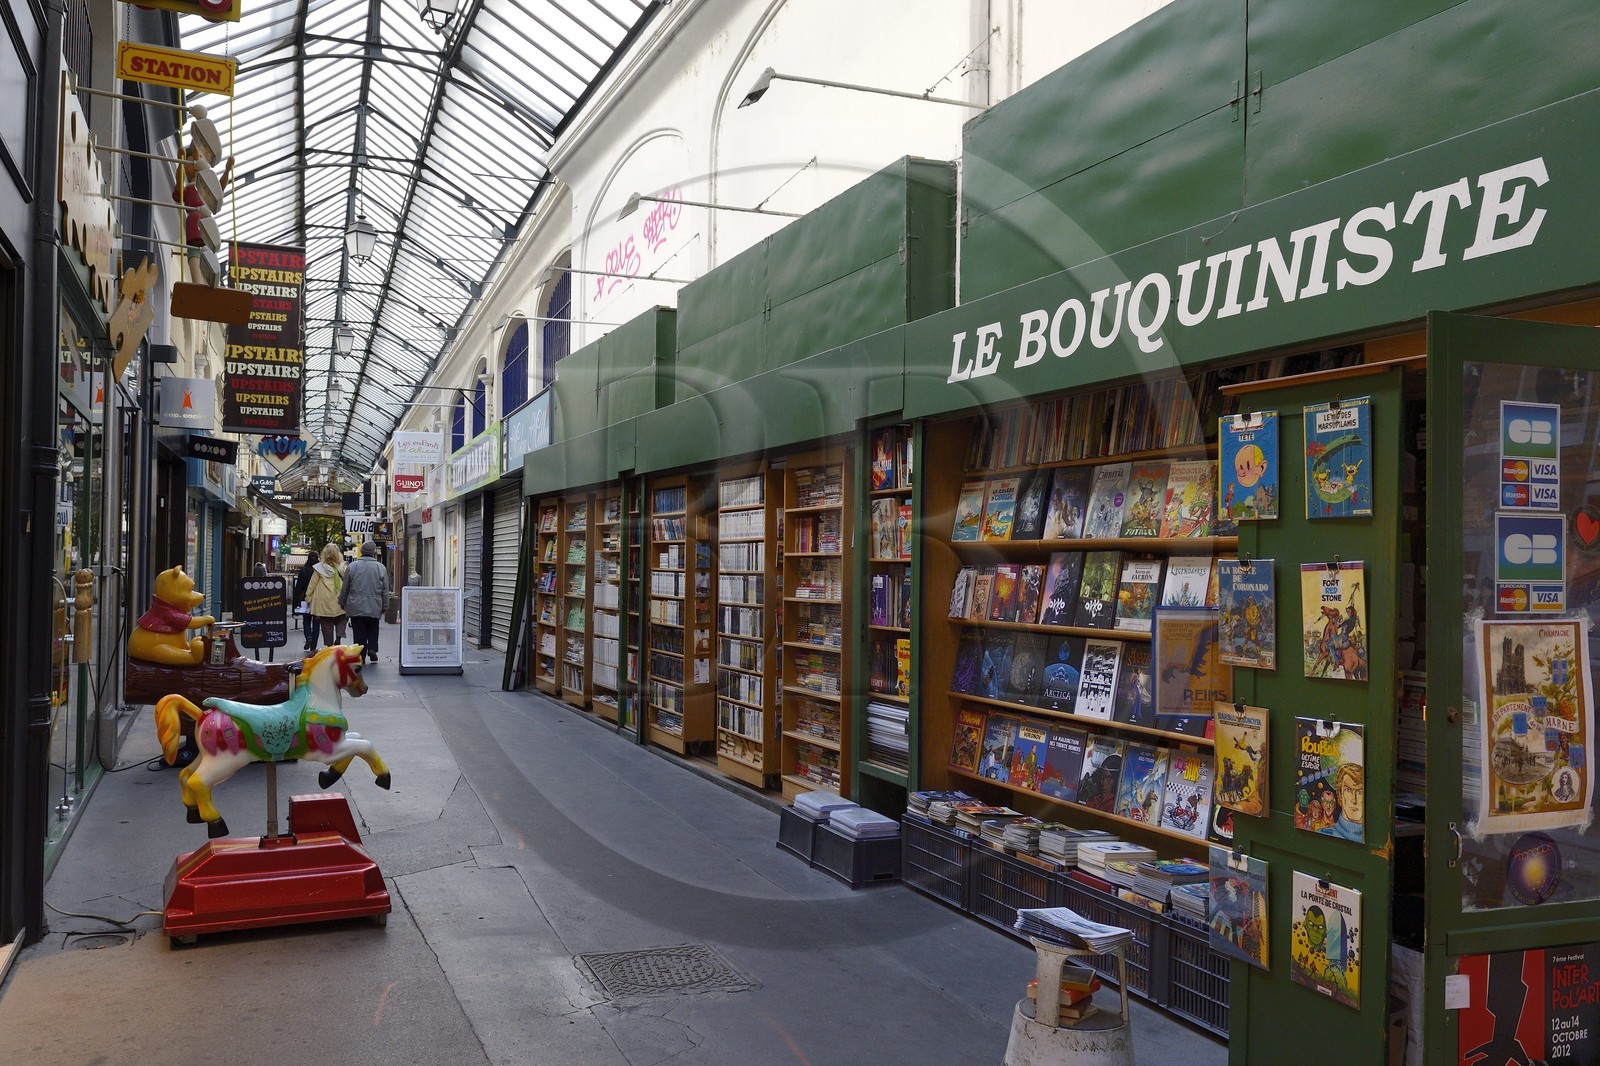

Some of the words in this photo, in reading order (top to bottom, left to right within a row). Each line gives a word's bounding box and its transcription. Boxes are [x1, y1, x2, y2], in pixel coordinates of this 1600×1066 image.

[130, 55, 222, 85] STATION
[230, 266, 302, 284] UPSTAIRS
[946, 321, 1003, 385] LE
[1013, 157, 1551, 368] BOUQUINISTE
[252, 298, 292, 311] STAIRS
[249, 311, 288, 322] PSTAIRS
[248, 322, 282, 332] UPSTAIRS
[226, 361, 300, 379] UPSTAIRS
[230, 378, 294, 392] UPSTAIRS
[236, 392, 289, 405] UPSTAIRS
[240, 406, 284, 416] UPSTAIRS
[1318, 418, 1356, 430] MARSUPILAMIS
[1324, 414, 1330, 422] LE
[1508, 418, 1552, 444] CB
[1098, 470, 1124, 480] ORBITAL
[1534, 464, 1557, 476] VISA
[1534, 488, 1557, 499] VISA
[1504, 533, 1558, 564] CB
[1221, 566, 1231, 574] LA
[1232, 575, 1242, 583] DE
[1232, 582, 1269, 592] CORONADO
[1500, 596, 1528, 604] MasterCard
[1536, 592, 1559, 603] VISA
[1538, 628, 1570, 639] CHAMPAGNE
[1044, 688, 1071, 700] ARCTICA
[1183, 689, 1227, 702] REIMS
[1545, 717, 1575, 732] MARNE
[1301, 890, 1308, 899] LA
[1308, 892, 1325, 905] PORTE
[1325, 898, 1332, 908] DE
[1332, 901, 1352, 916] CRISTAL
[1552, 954, 1566, 963] 7ème
[1567, 953, 1584, 962] Festival
[1552, 964, 1590, 990] INTER
[1552, 980, 1600, 1010] POL'ART
[1552, 1018, 1560, 1030] 12
[1571, 1015, 1580, 1028] 14
[1552, 1029, 1588, 1044] OCTOBRE
[1552, 1044, 1571, 1058] 2012
